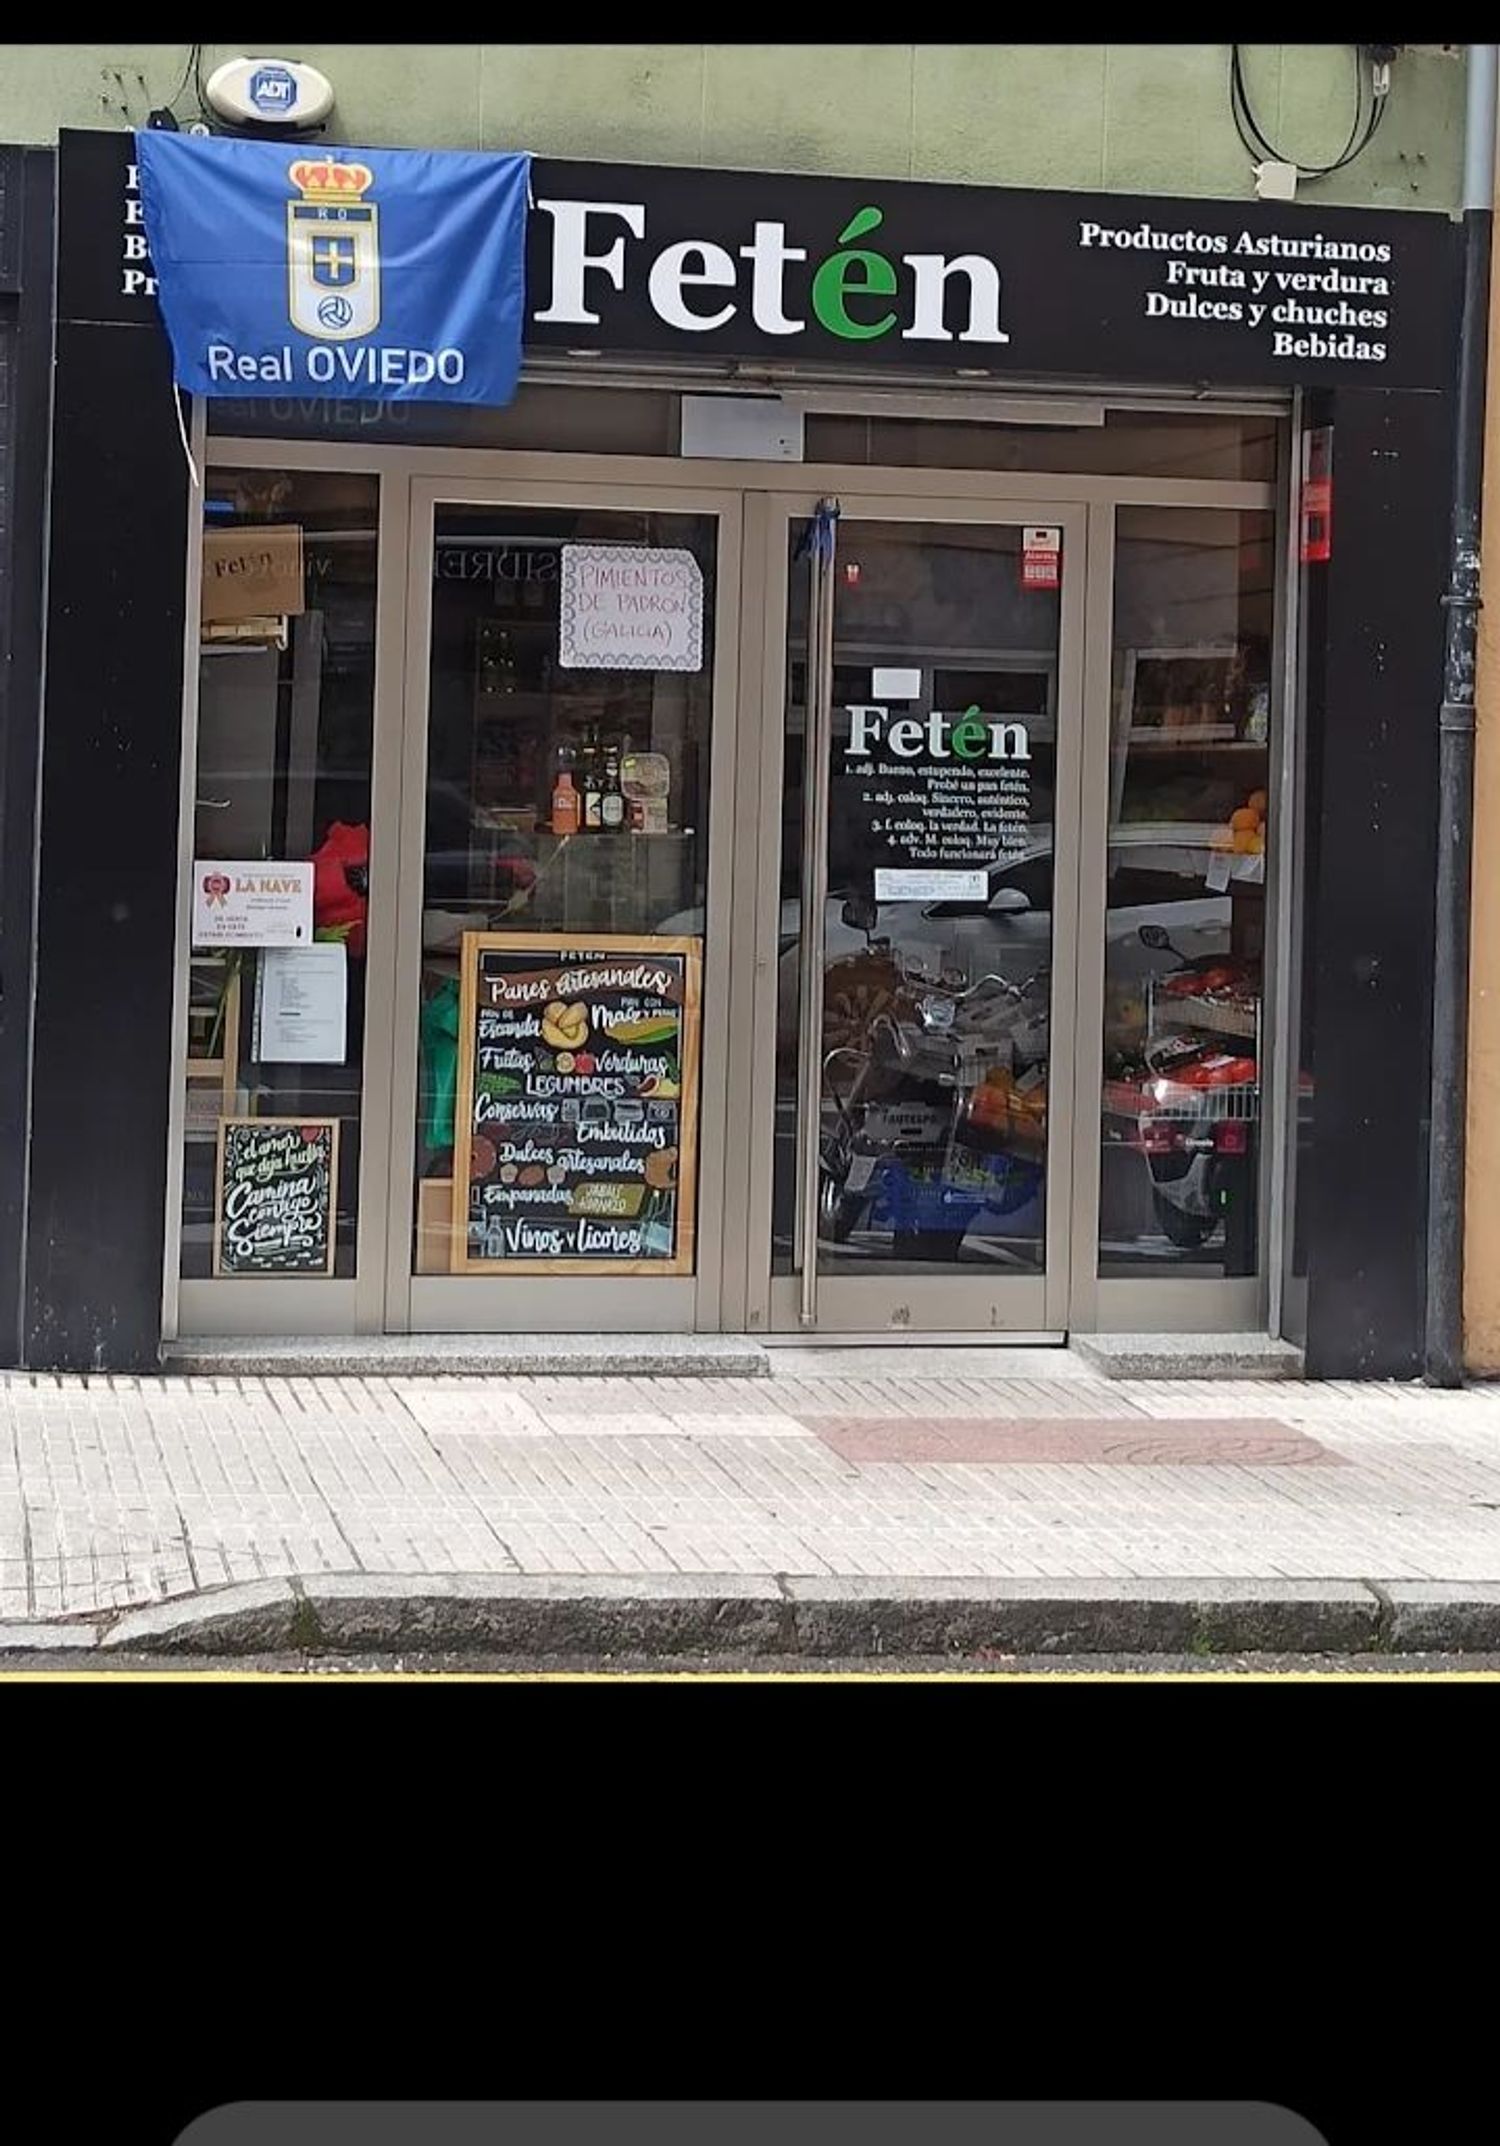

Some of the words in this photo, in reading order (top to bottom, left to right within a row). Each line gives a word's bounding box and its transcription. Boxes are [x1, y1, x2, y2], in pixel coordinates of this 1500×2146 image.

[257, 80, 290, 99] ADT
[1079, 221, 1227, 253] Productos
[1235, 230, 1391, 263] Asturianos
[533, 198, 1010, 345] Fetén
[1166, 261, 1246, 290] Fruta
[1253, 271, 1271, 297] y
[1276, 266, 1390, 295] verdura
[1146, 293, 1242, 322] Dulces
[1247, 303, 1266, 328] y
[1271, 298, 1388, 328] chuches
[1273, 332, 1387, 361] Bebidas
[208, 345, 292, 382] Real
[308, 346, 464, 384] OVIEDO
[214, 552, 273, 578] Fetn
[580, 565, 688, 589] PIMIENTOS
[578, 594, 600, 614] DE
[582, 619, 673, 647] (GALICIA)
[844, 704, 1032, 760] Fetén
[961, 782, 975, 790] un
[977, 782, 998, 793] pan
[235, 878, 256, 893] LA
[260, 879, 302, 893] NAVE
[484, 976, 550, 1003] Panes
[480, 1047, 536, 1072] Frutas
[594, 1047, 669, 1077] Verduras
[526, 1075, 626, 1099] LEGUMBRES
[474, 1092, 559, 1122] Conservas
[576, 1120, 666, 1148] Embutidos
[499, 1140, 554, 1164] Dulces
[506, 1217, 564, 1253] Vinos
[576, 1217, 642, 1253] licores
